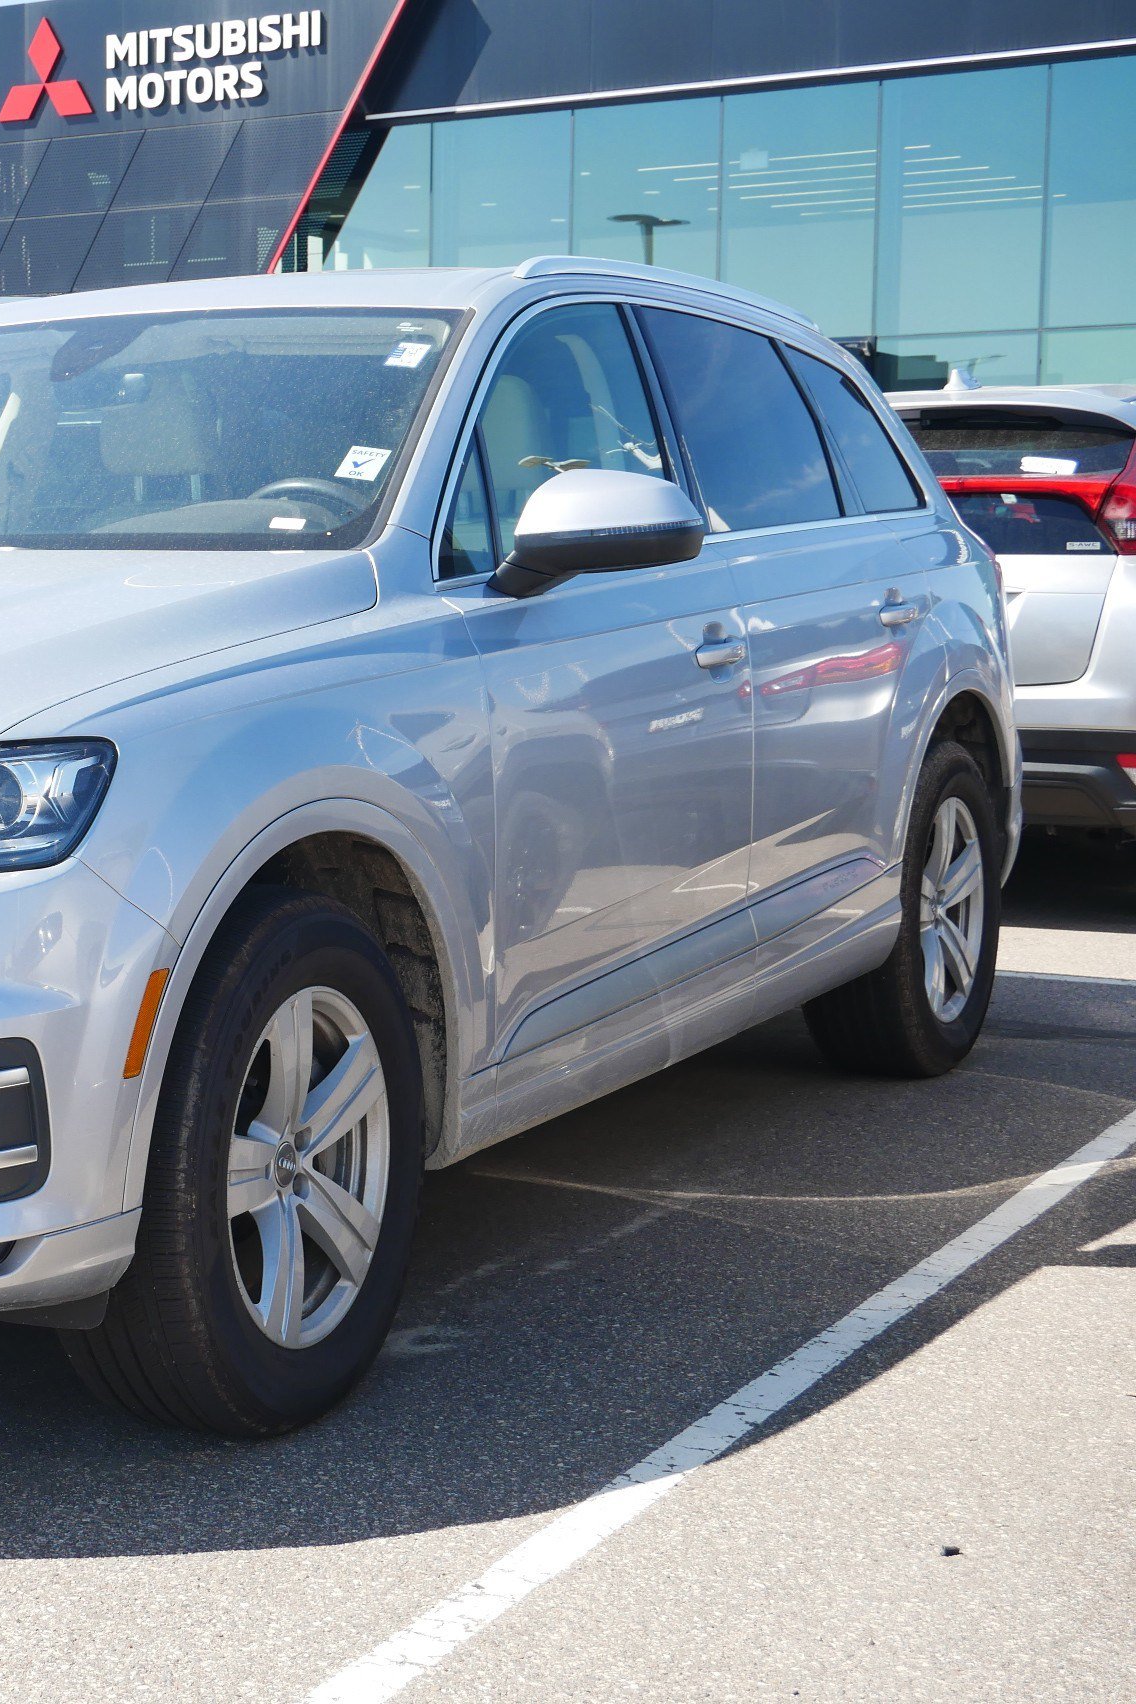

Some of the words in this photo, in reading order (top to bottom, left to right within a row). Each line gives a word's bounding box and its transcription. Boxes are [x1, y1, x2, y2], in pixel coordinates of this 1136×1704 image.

[105, 9, 321, 70] MITSUBISHI
[105, 61, 263, 112] MOTORS
[351, 449, 387, 458] SAFETY
